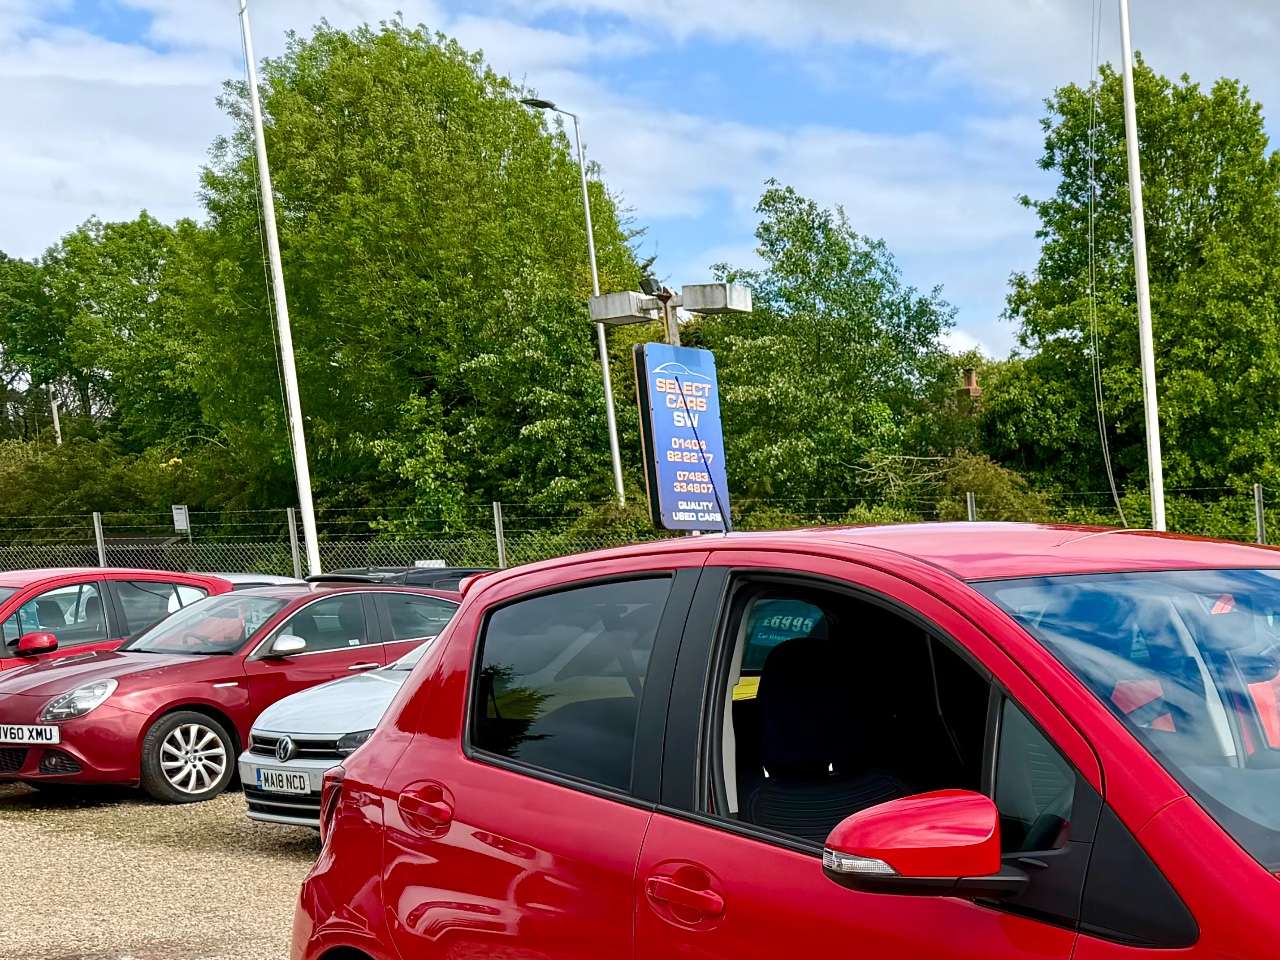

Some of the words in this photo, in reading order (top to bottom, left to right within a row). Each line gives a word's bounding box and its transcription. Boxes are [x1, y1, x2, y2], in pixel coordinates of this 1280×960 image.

[656, 378, 712, 396] SELECT
[666, 395, 707, 411] CARS
[673, 412, 699, 427] SW
[672, 438, 706, 450] 01404
[678, 501, 713, 510] QUALITY
[673, 512, 696, 520] USED
[698, 513, 721, 521] CARS
[28, 727, 53, 741] XMU
[263, 772, 284, 788] MA18
[286, 774, 306, 790] NCD
